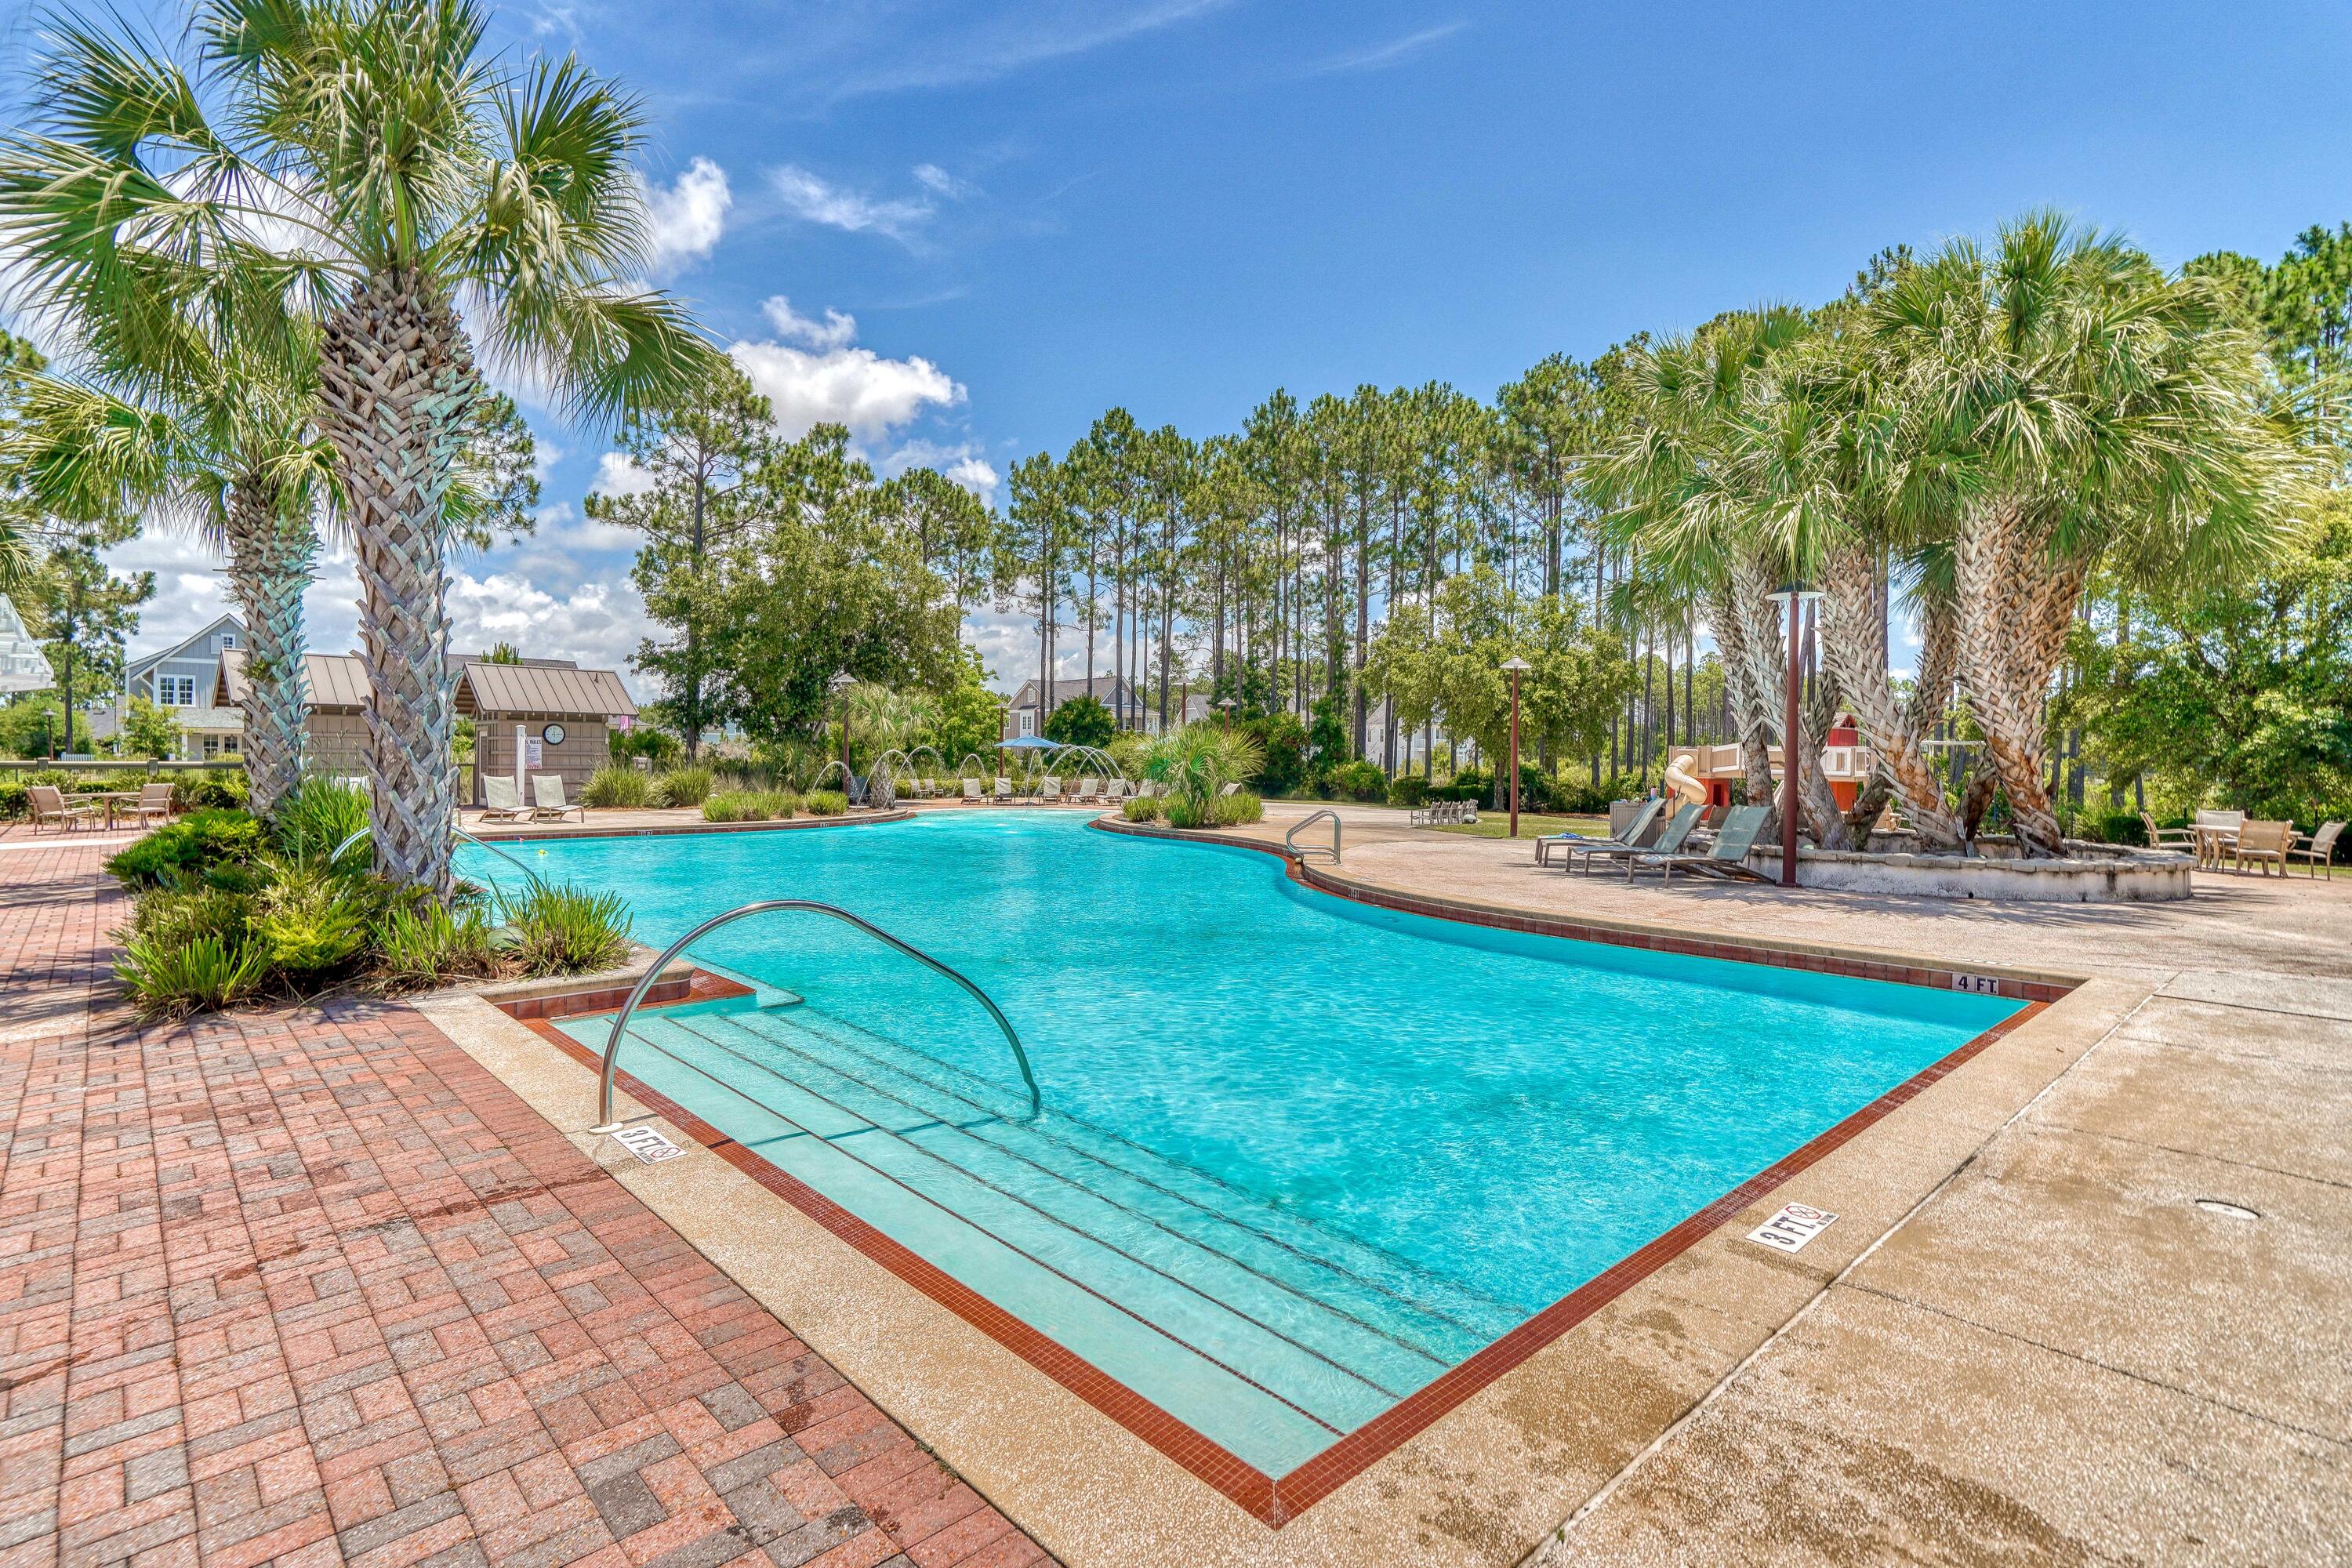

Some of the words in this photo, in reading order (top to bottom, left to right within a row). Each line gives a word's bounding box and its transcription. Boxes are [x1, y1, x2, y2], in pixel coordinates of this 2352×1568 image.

[1958, 975, 1969, 990] 4
[1976, 977, 1998, 993] FT.
[620, 1129, 649, 1138] 3
[629, 1135, 666, 1152] FT.
[1770, 1216, 1817, 1236] FT.
[1759, 1232, 1796, 1245] 3
